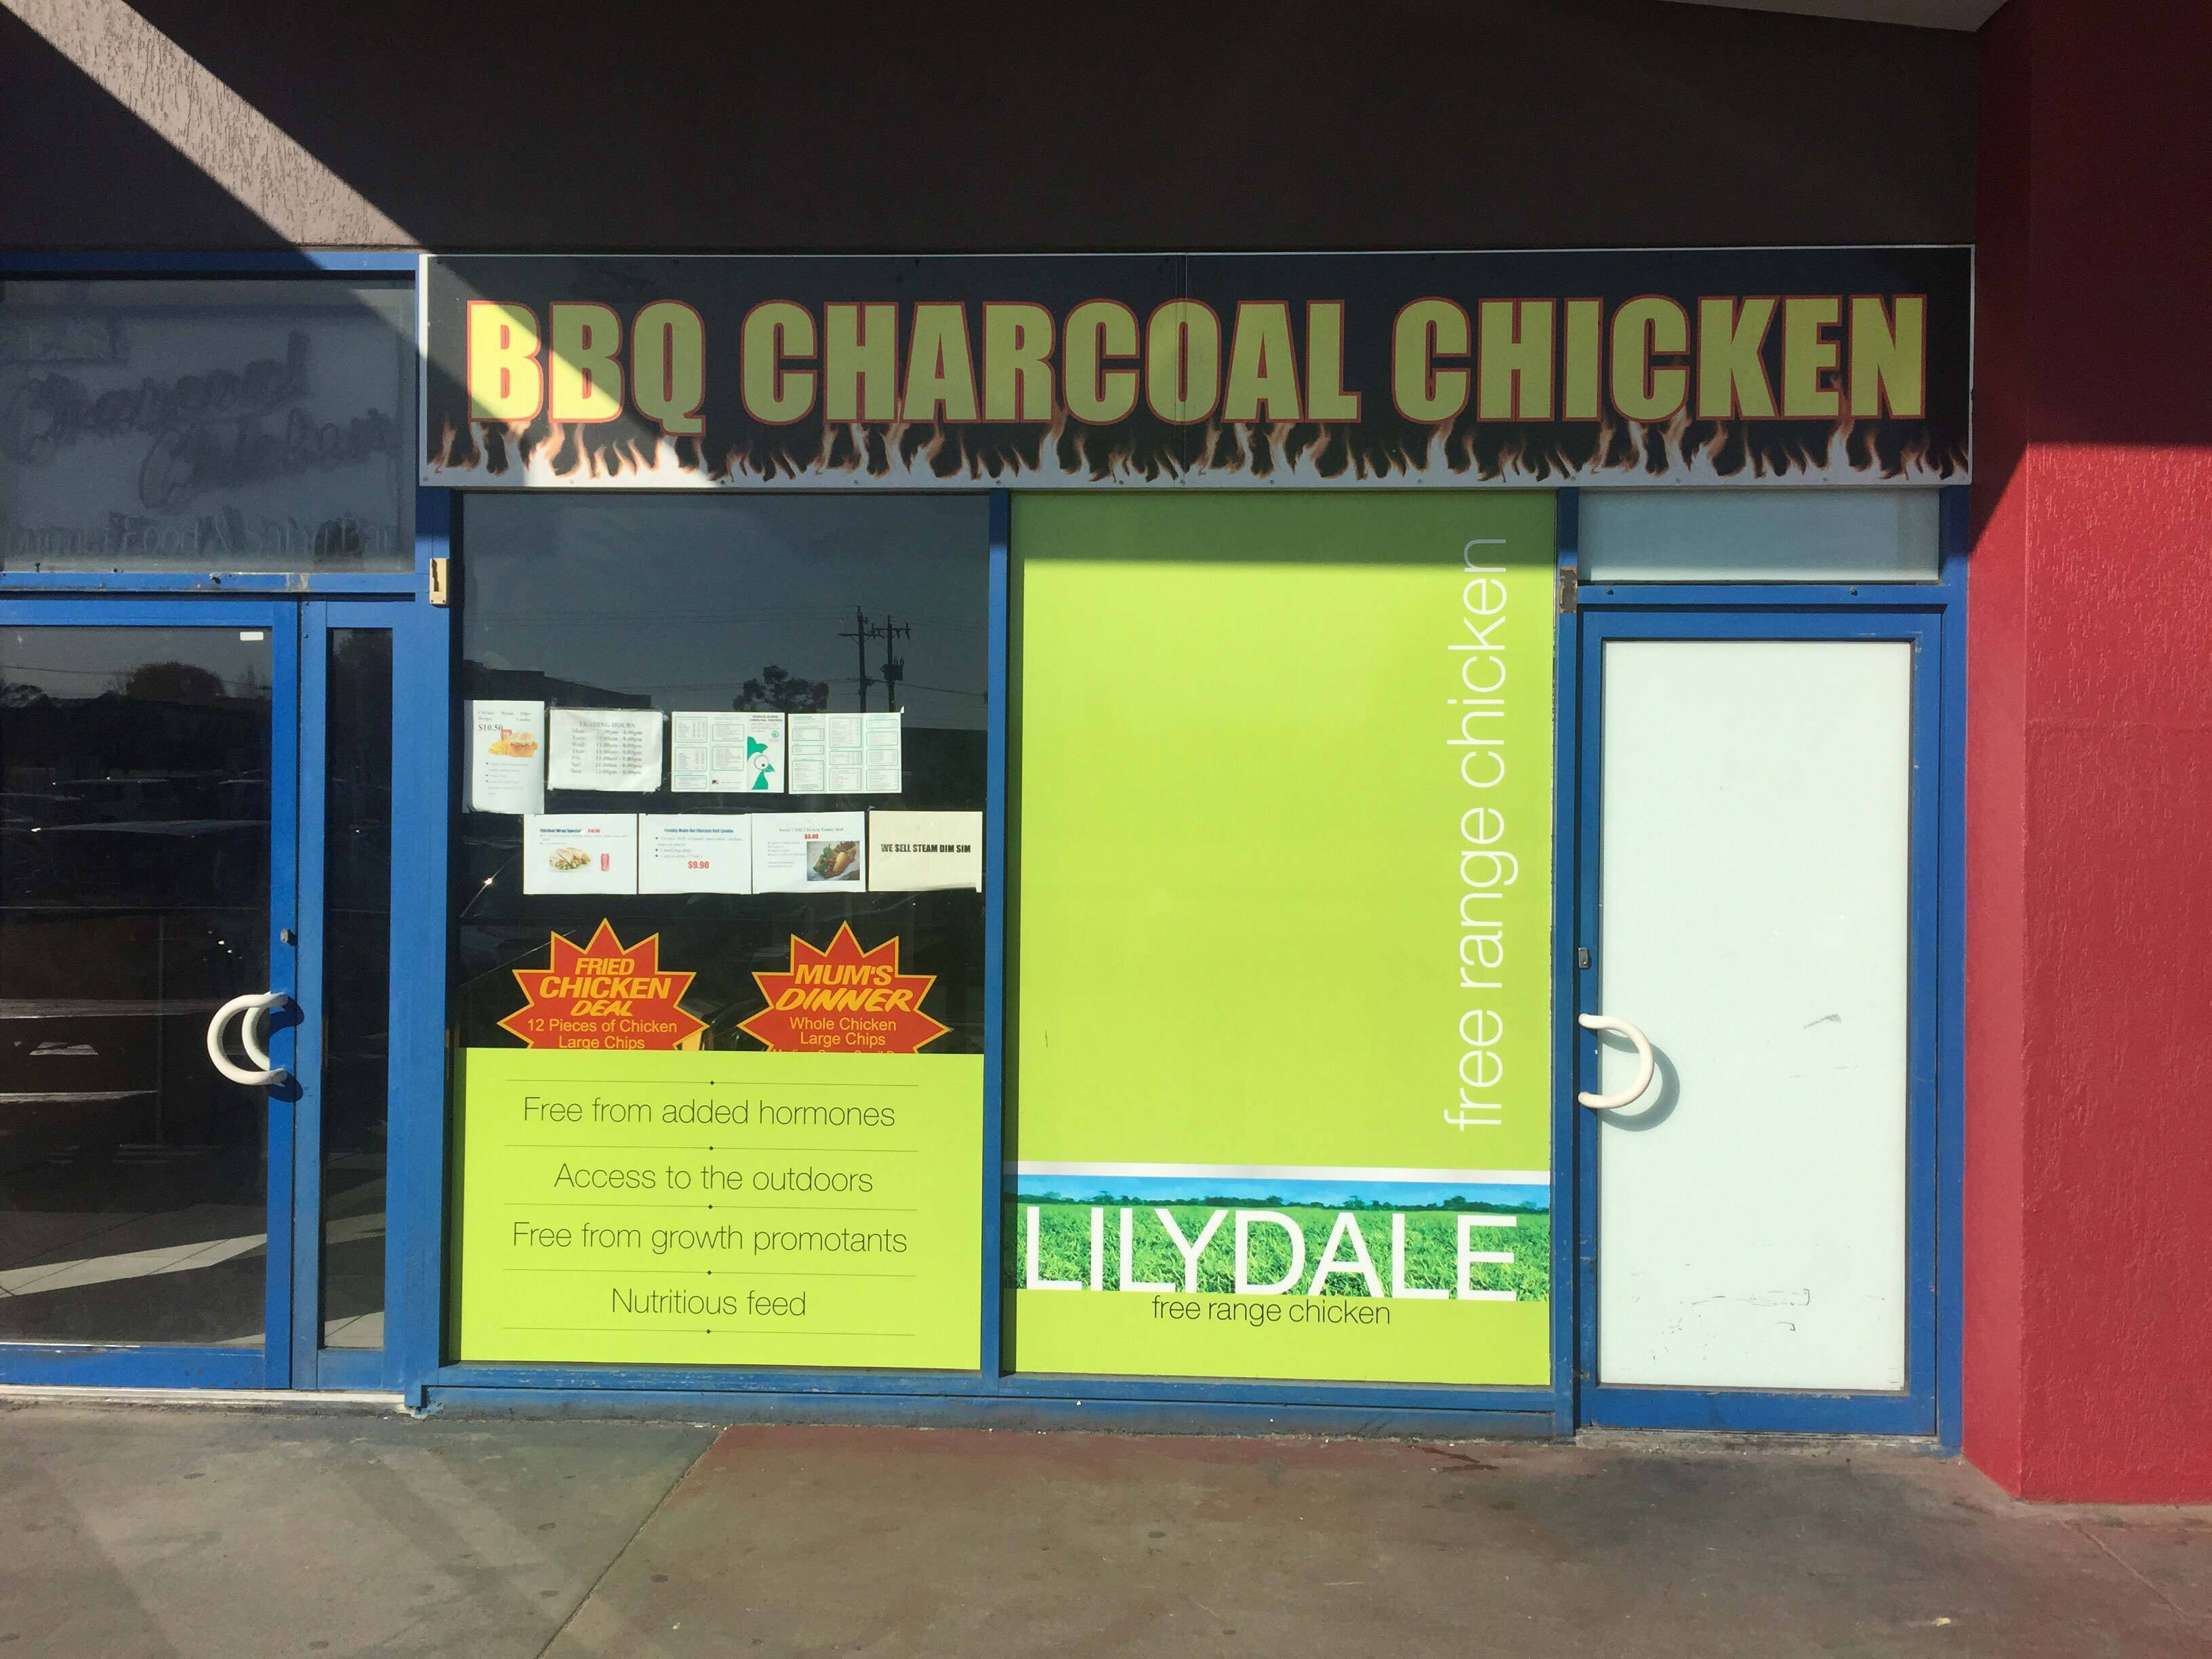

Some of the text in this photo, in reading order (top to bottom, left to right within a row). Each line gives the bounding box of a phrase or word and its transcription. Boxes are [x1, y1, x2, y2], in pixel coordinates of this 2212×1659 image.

[467, 300, 705, 436] BBQ
[740, 298, 1361, 425] CHARCOAL
[1391, 293, 1927, 425] CHICKEN
[1444, 539, 1517, 1131] free range chicken
[881, 844, 970, 853] WE SELL STEAM DIM SIM
[688, 861, 710, 869] $9.90
[575, 958, 635, 975] FRIED
[795, 964, 894, 985] MUM'S
[539, 976, 672, 999] CHICKEN
[571, 1000, 633, 1017] DEAL
[775, 988, 914, 1012] DINNER
[527, 1019, 677, 1033] 12 Pieces of Chicken
[790, 1017, 896, 1031] Whole Chicken
[559, 1036, 645, 1050] Large Chips
[800, 1031, 886, 1048] Large Chips
[524, 1097, 895, 1127] Free from added hormones
[554, 1164, 874, 1193] Access to the outdoors
[513, 1223, 907, 1256] Free from growth promotants
[1026, 1206, 1517, 1301] LILYDALE
[612, 1288, 806, 1317] Nutritious feed
[1152, 1296, 1390, 1327] free range chicken
